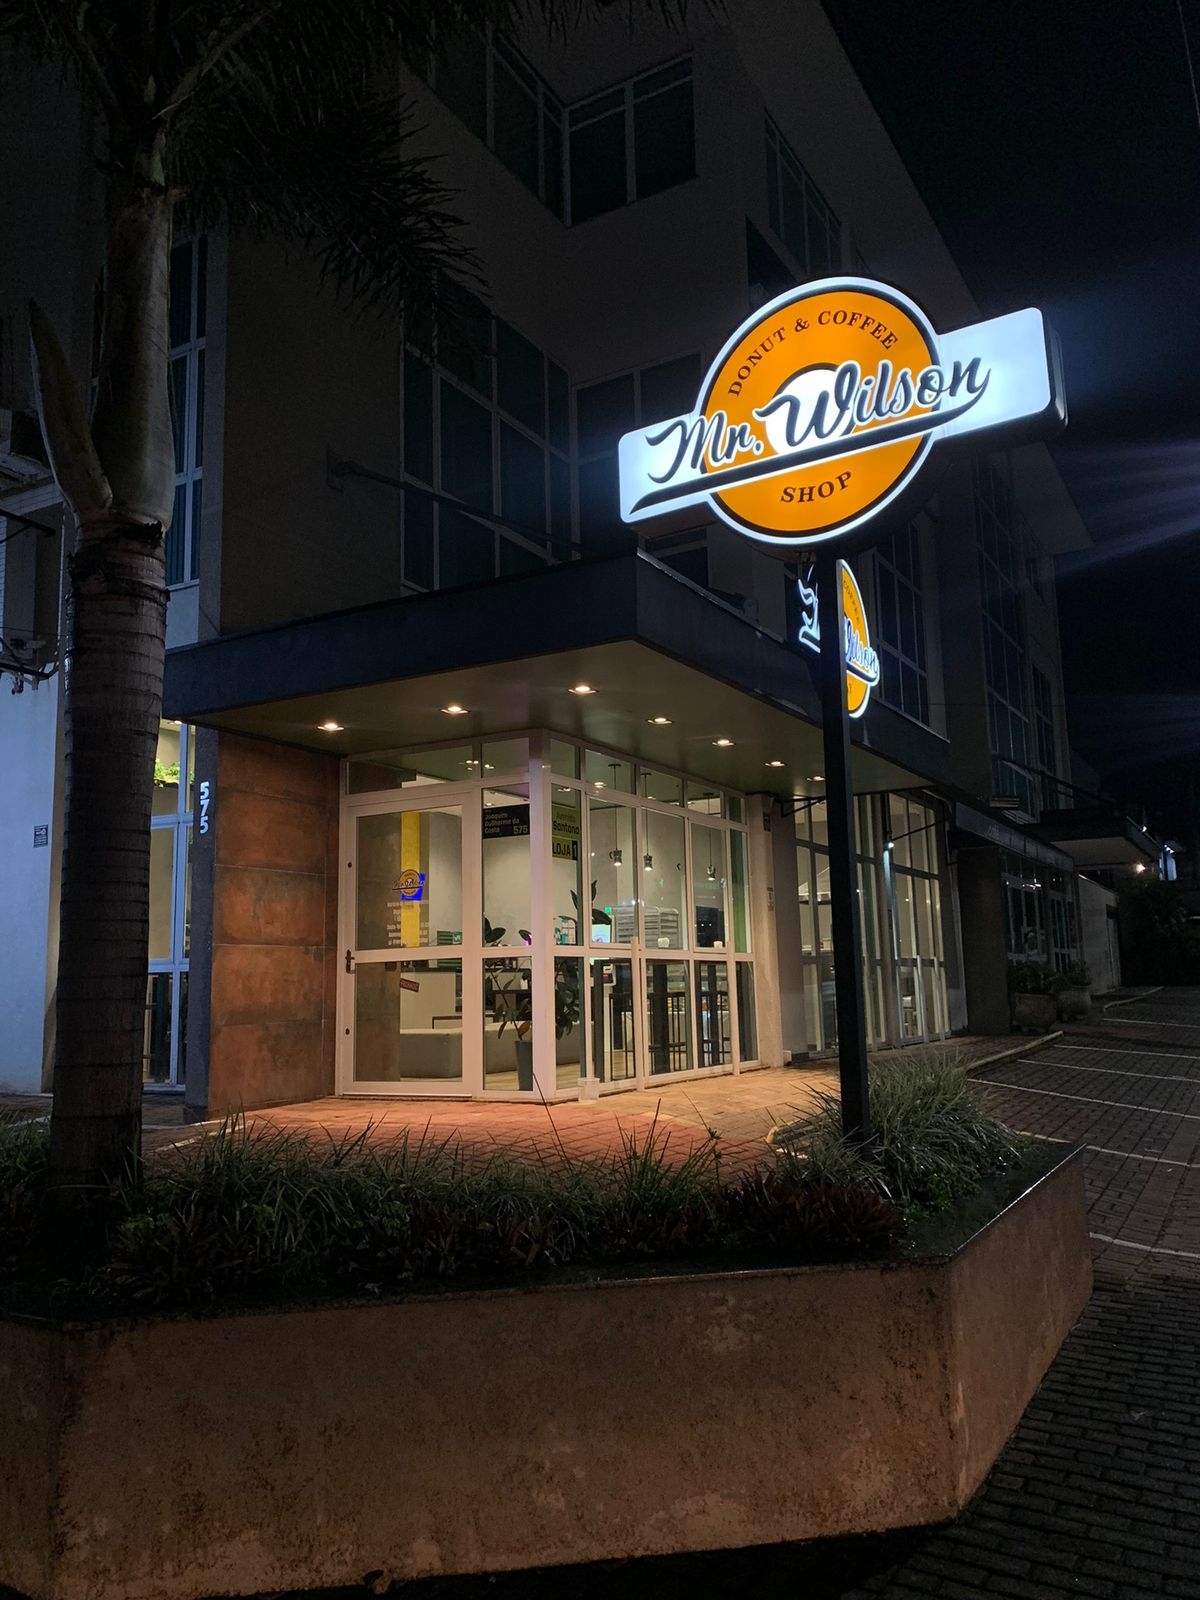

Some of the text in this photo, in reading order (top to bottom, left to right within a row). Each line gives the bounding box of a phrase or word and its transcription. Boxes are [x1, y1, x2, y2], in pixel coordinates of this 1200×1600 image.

[728, 309, 898, 396] DONUT & COFFEE
[645, 355, 992, 484] Mr. Wilson
[780, 471, 852, 503] SHOP
[200, 781, 210, 834] 575
[513, 825, 529, 835] 575
[552, 841, 571, 857] LOJA
